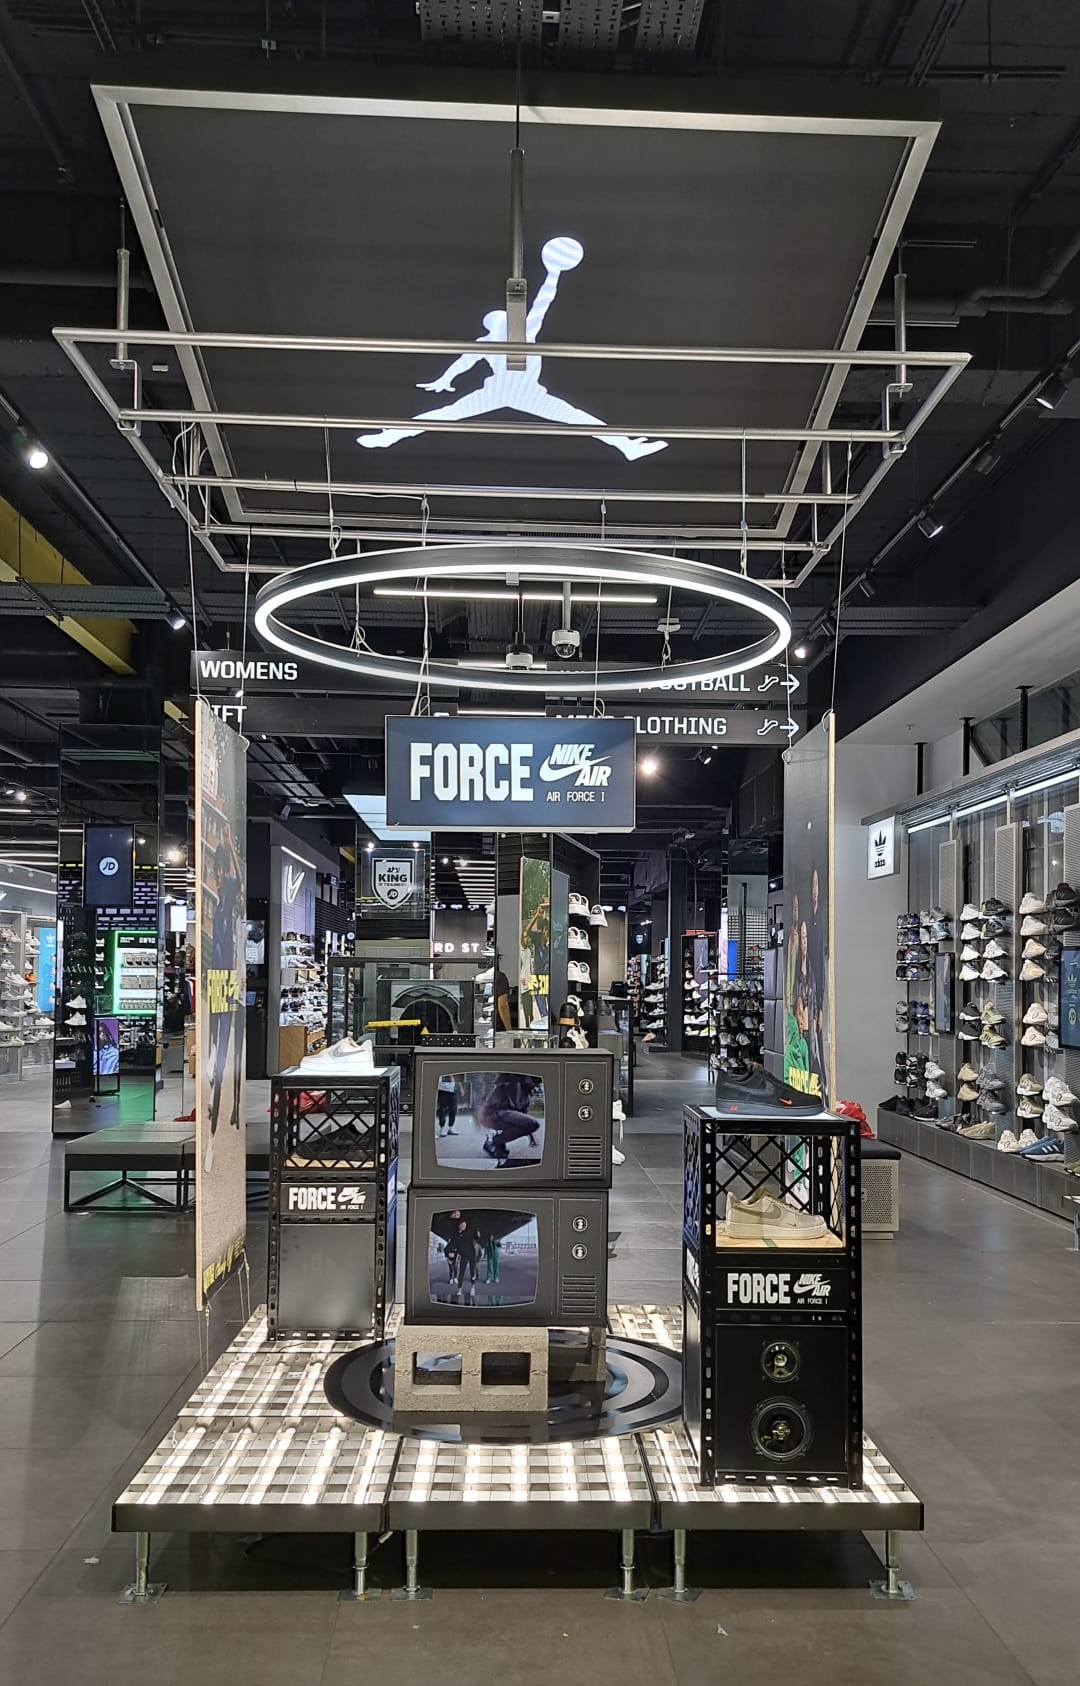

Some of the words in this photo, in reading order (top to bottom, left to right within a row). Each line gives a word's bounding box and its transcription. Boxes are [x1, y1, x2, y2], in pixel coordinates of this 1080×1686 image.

[200, 660, 298, 680] WOMENS
[211, 704, 247, 722] IFT
[636, 716, 727, 735] LOTHING
[550, 744, 595, 765] NIKE
[410, 743, 534, 801] FORCE
[575, 765, 612, 786] AIR
[546, 792, 561, 802] AIR
[567, 792, 595, 801] FORCE
[378, 873, 408, 883] KING
[461, 943, 480, 953] ST
[288, 1187, 337, 1210] FORCE
[727, 1273, 791, 1304] FORCE
[798, 1273, 823, 1285] NIKE
[811, 1285, 832, 1296] AIR
